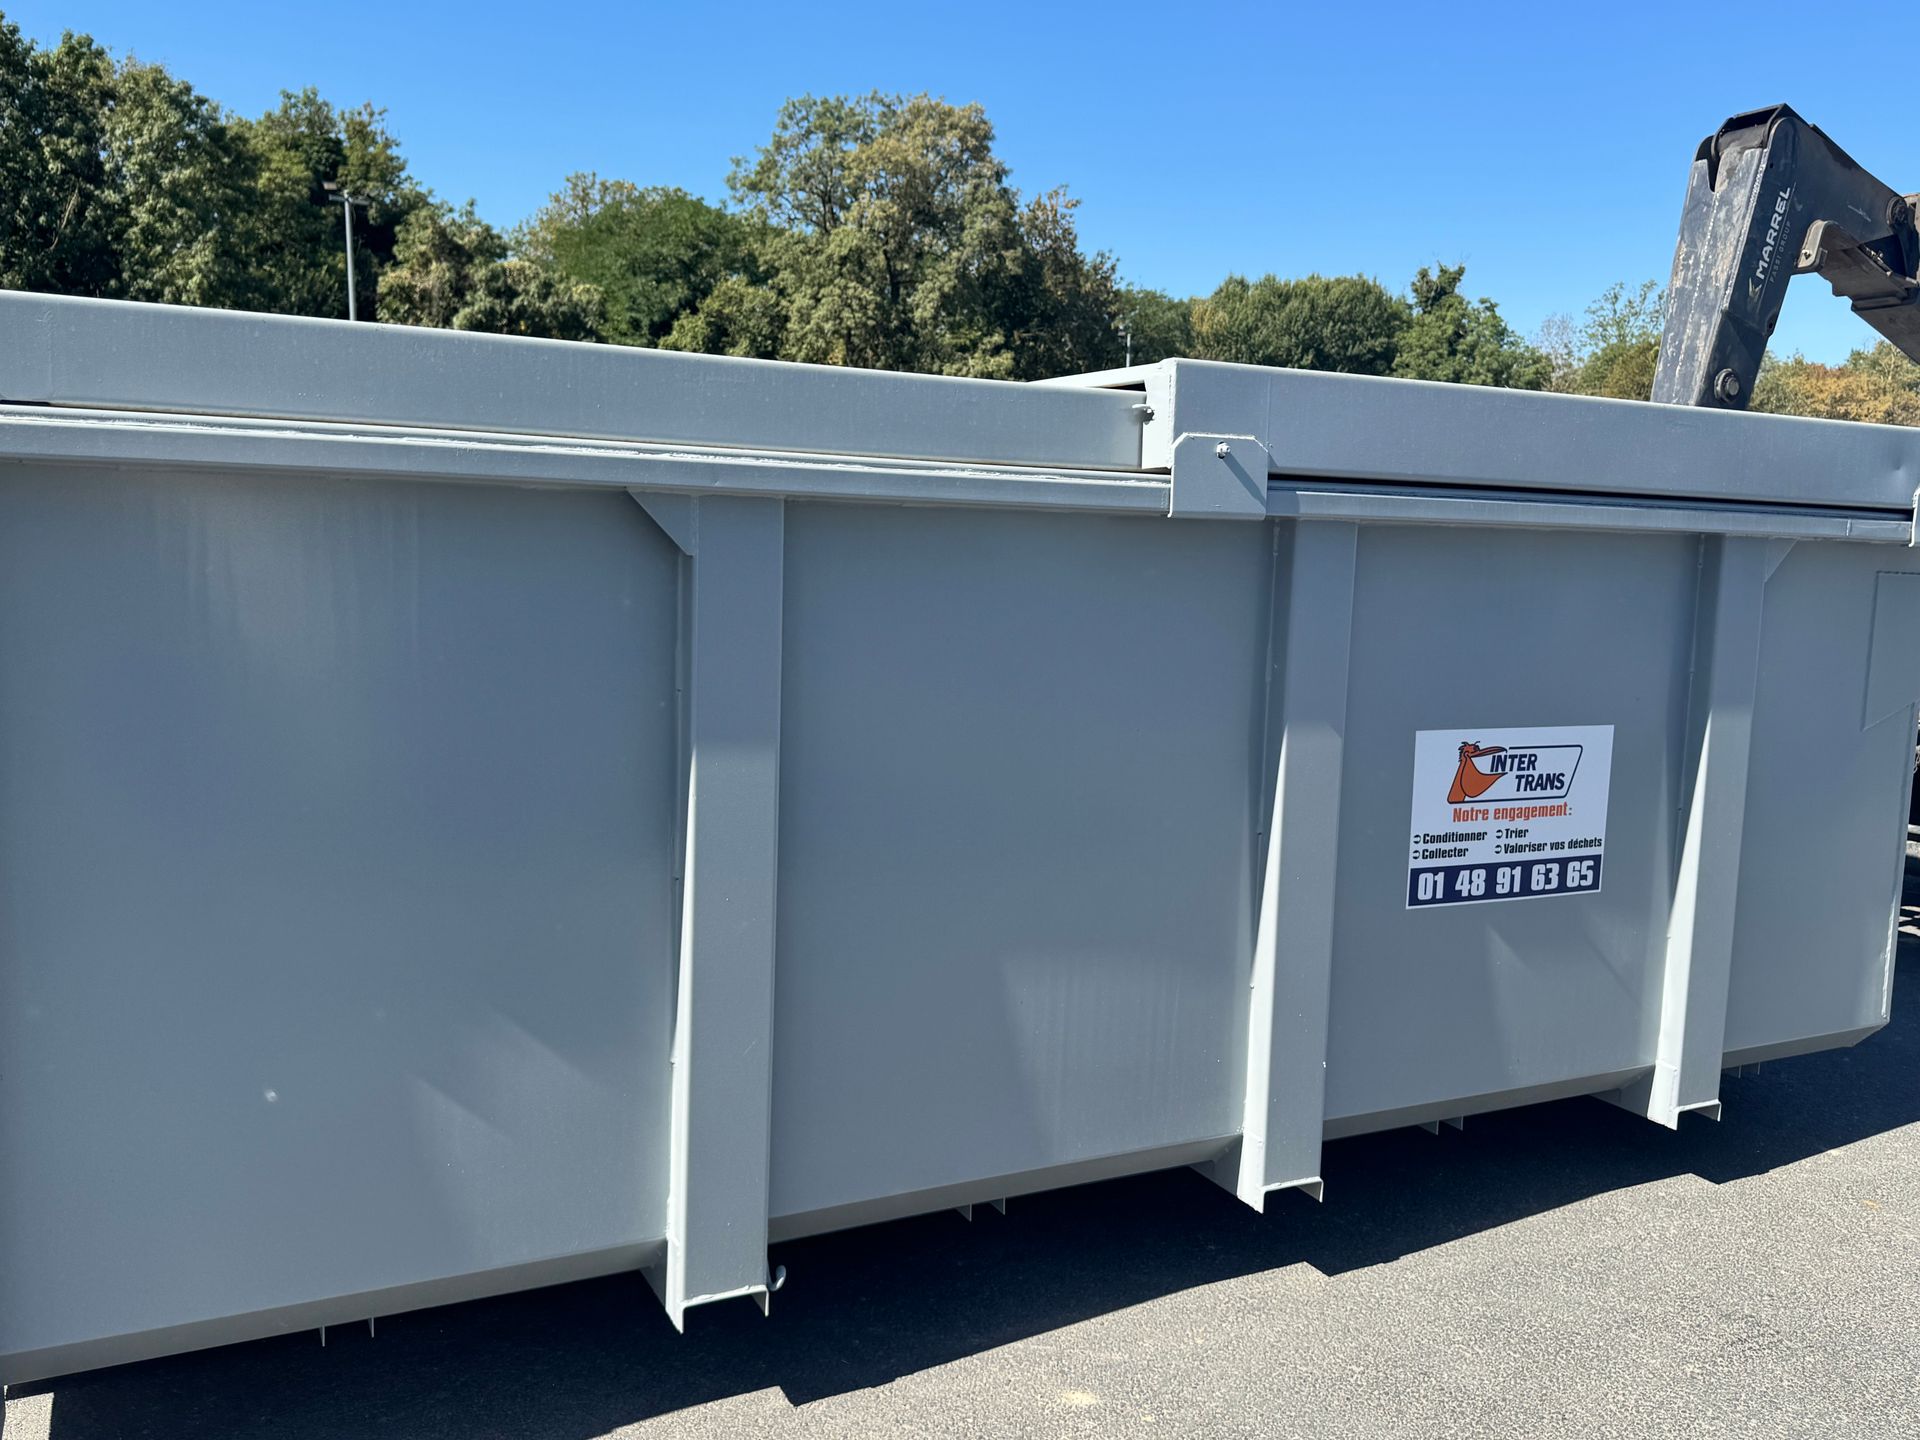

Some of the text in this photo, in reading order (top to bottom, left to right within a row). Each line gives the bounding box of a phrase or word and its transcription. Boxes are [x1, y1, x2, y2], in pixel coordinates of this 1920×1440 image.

[1756, 187, 1790, 279] MARREL
[1779, 221, 1792, 253] GROUP
[1490, 754, 1537, 773] INTER
[1515, 773, 1565, 792] TRANS
[1453, 807, 1489, 822] Notre
[1423, 830, 1487, 844] Conditionner
[1505, 828, 1529, 839] Trier
[1422, 847, 1468, 860] Collecter
[1504, 837, 1602, 855] Valoriser vos déchets
[1417, 860, 1594, 900] 01 48 91 63 65
